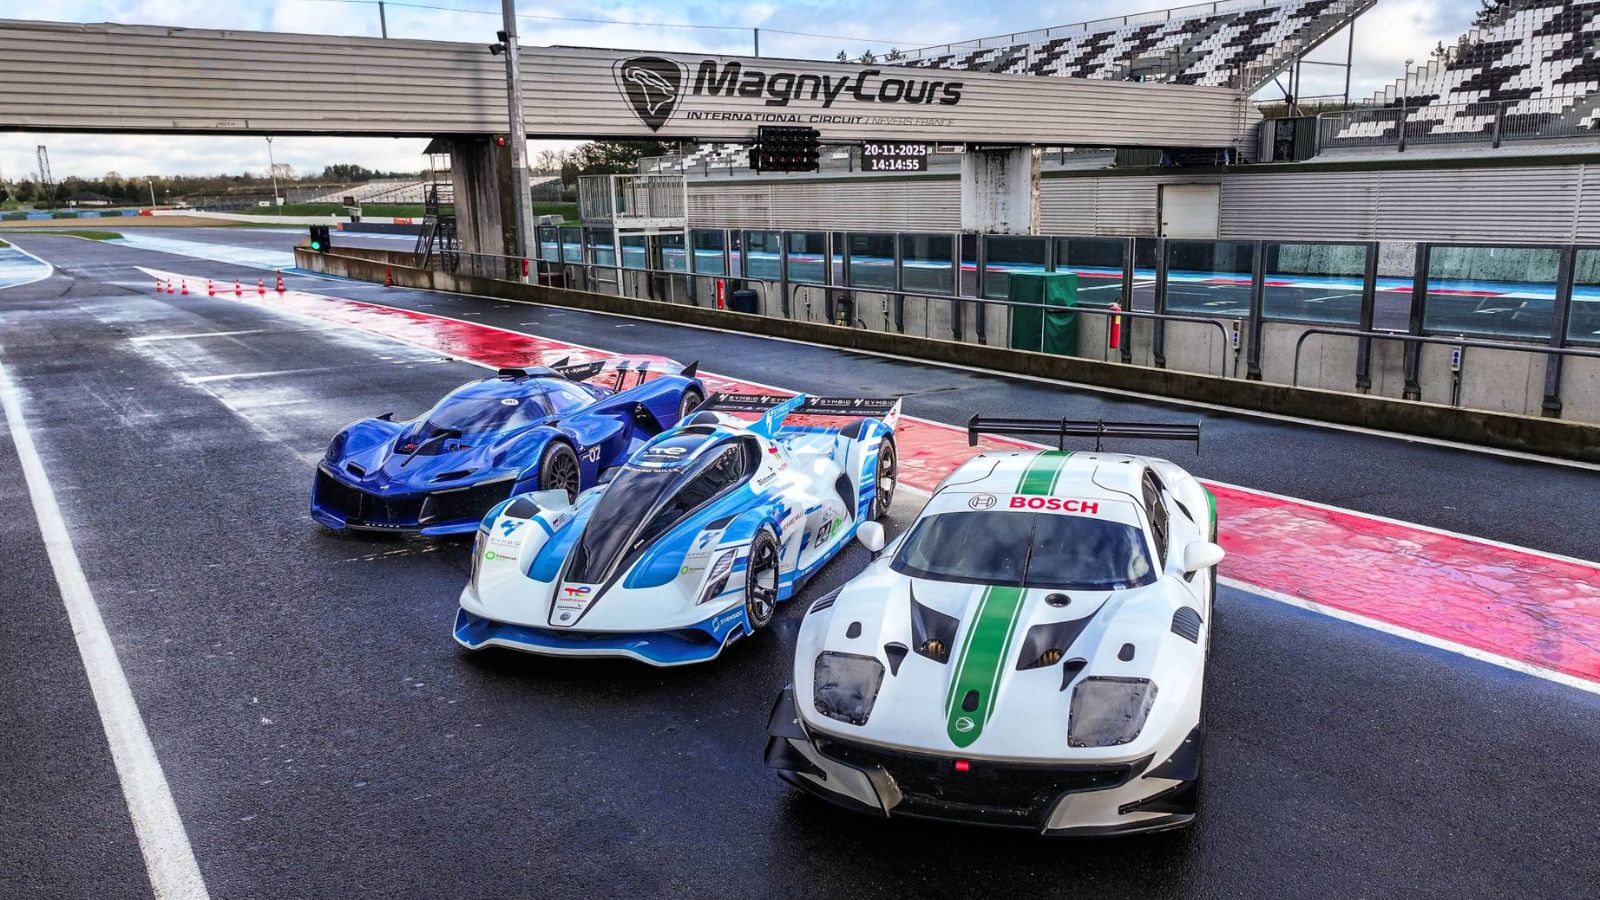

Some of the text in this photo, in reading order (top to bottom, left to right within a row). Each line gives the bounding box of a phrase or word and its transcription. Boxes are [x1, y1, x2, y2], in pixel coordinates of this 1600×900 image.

[693, 60, 963, 107] Magny-Cours
[687, 111, 803, 122] INTERNATIONAL
[809, 115, 863, 124] CIRCUIT
[864, 145, 926, 156] 20-11-2025
[871, 159, 920, 170] 14:14:55
[1009, 496, 1099, 515] BOSCH
